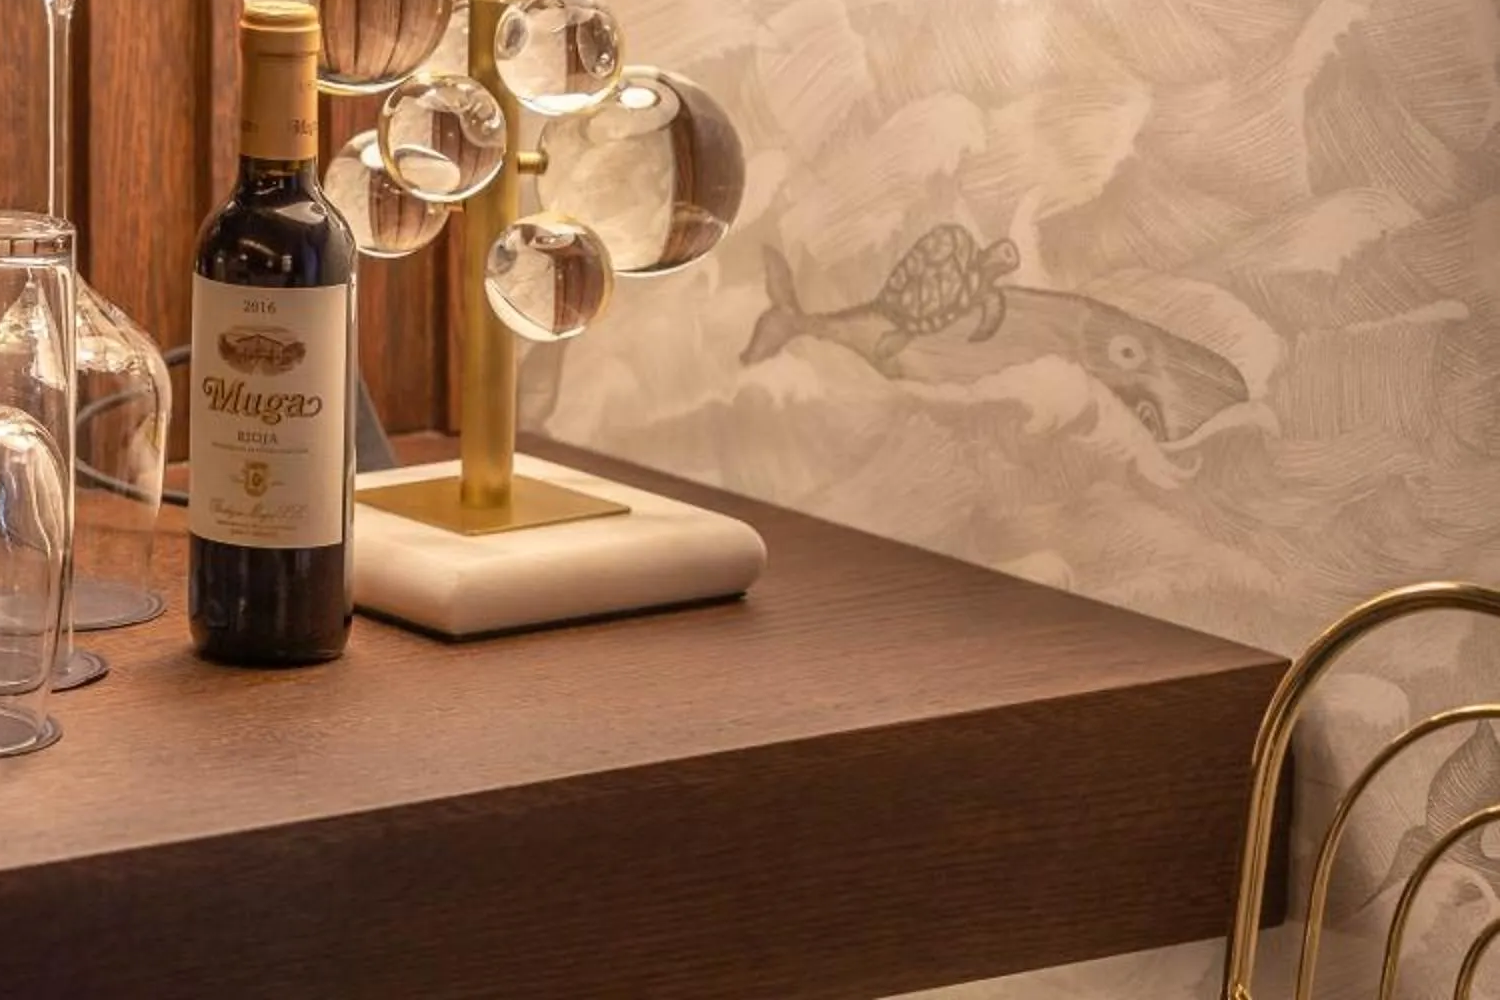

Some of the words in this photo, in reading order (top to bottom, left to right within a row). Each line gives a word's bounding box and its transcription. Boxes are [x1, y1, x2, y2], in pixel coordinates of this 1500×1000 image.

[244, 299, 277, 314] 2016
[203, 376, 323, 426] Muga
[237, 431, 278, 445] RIOJA
